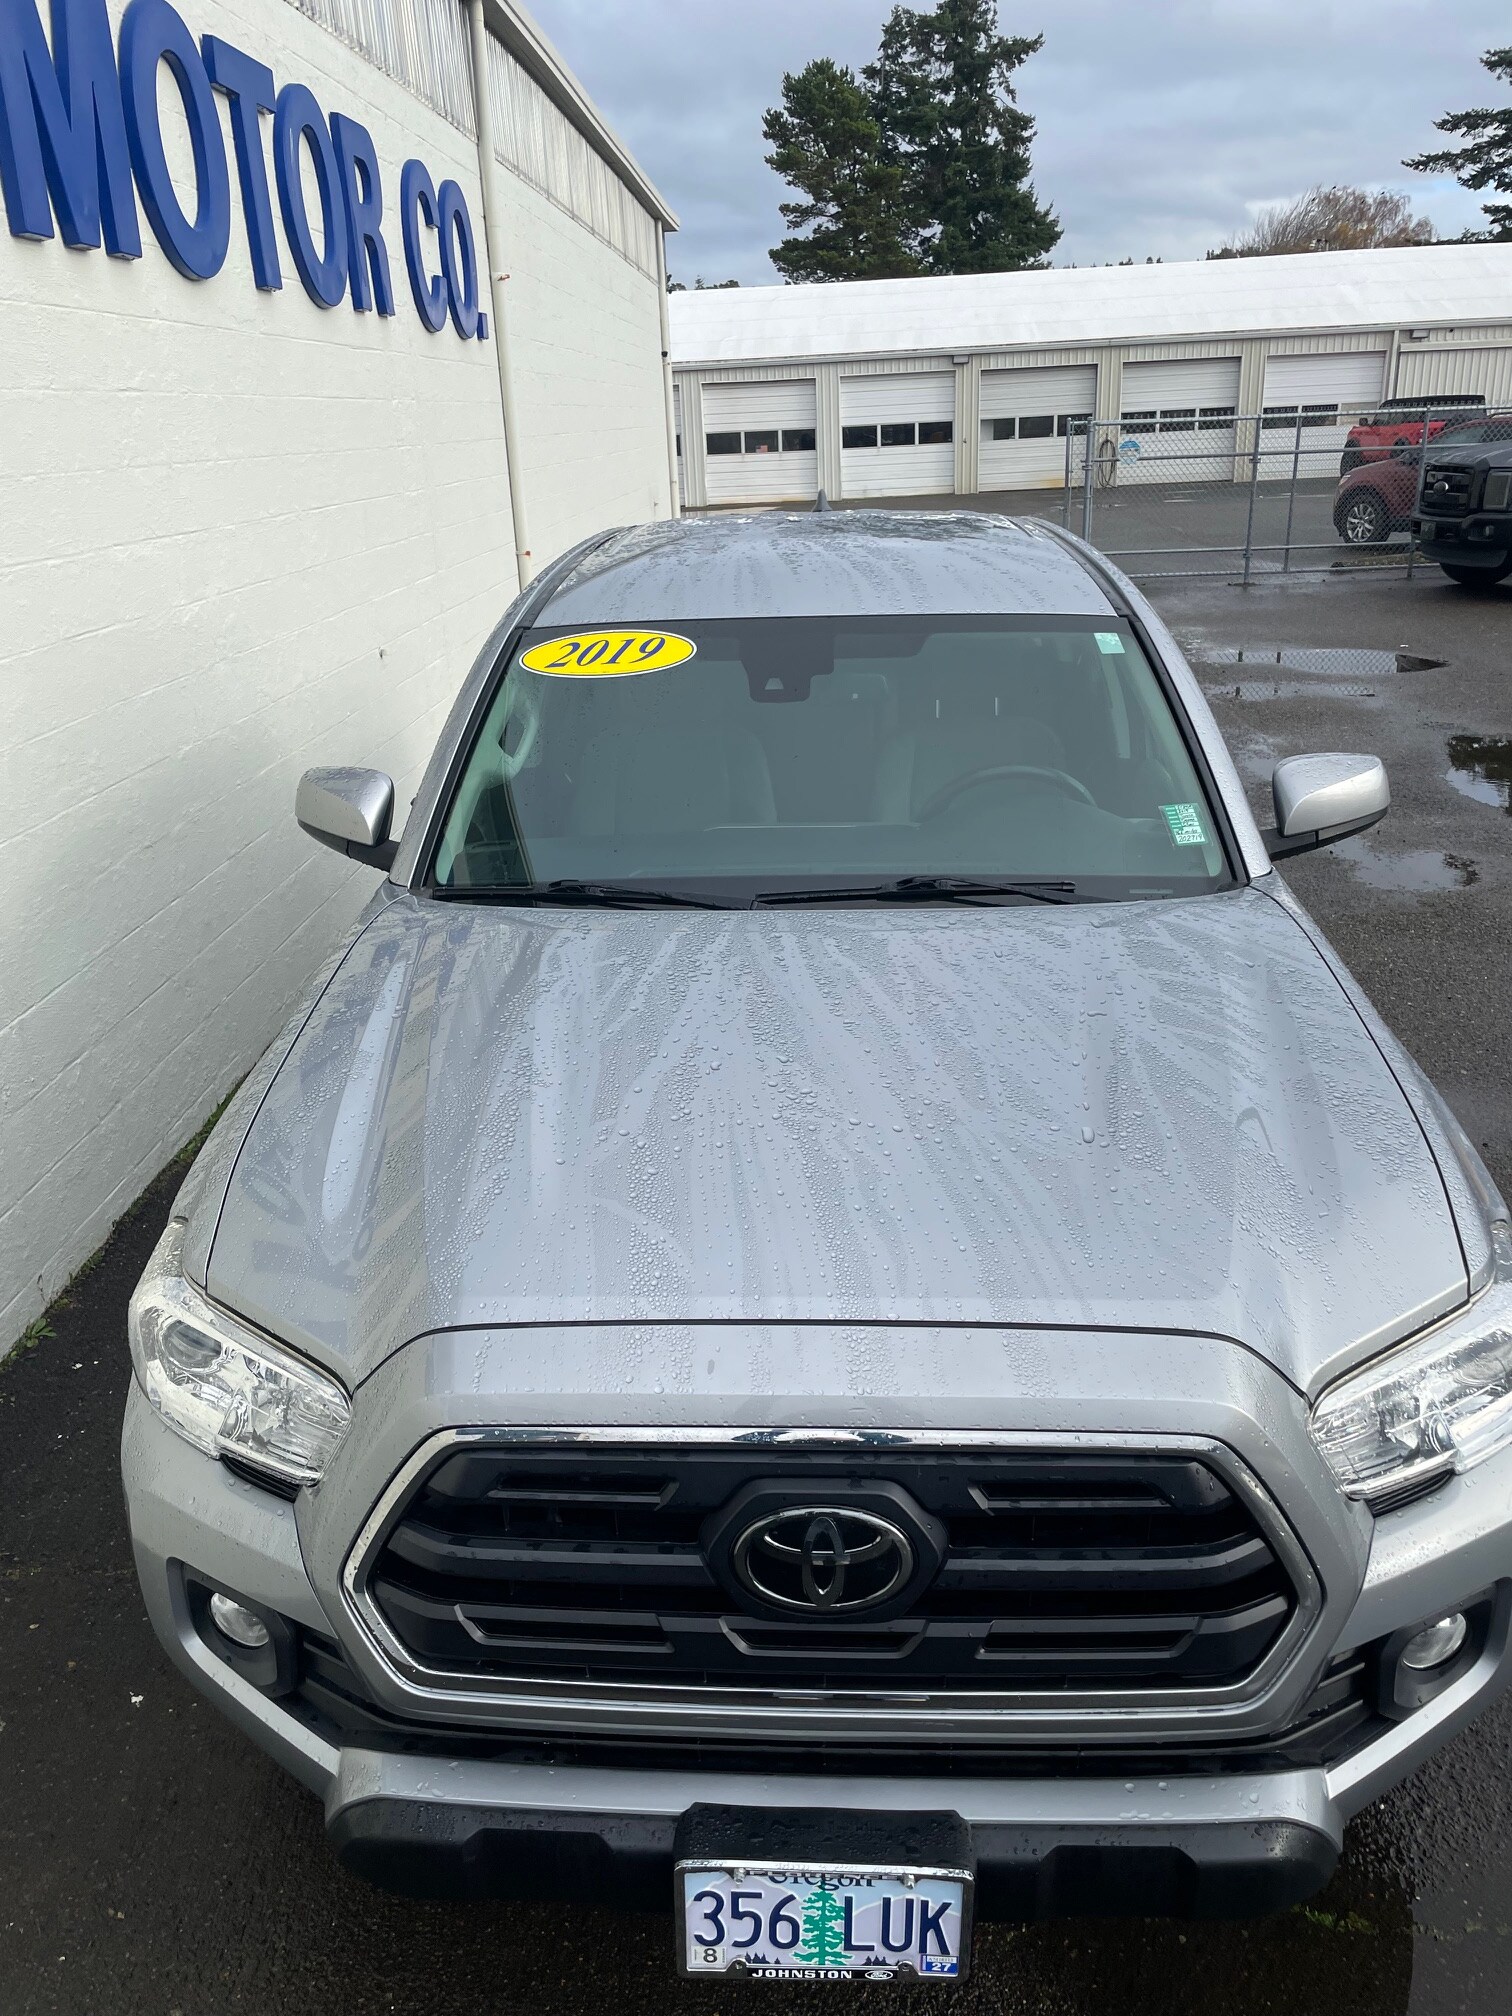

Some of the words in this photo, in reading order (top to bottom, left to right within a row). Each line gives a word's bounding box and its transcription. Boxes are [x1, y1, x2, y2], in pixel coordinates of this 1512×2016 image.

[0, 0, 395, 316] MOTOR
[400, 159, 489, 340] CO.
[544, 637, 666, 668] 2019
[693, 1890, 800, 1949] 356
[843, 1895, 953, 1954] LUK
[703, 1948, 718, 1963] 8
[932, 1962, 951, 1971] 27
[752, 1969, 852, 1979] JOHNSTON
